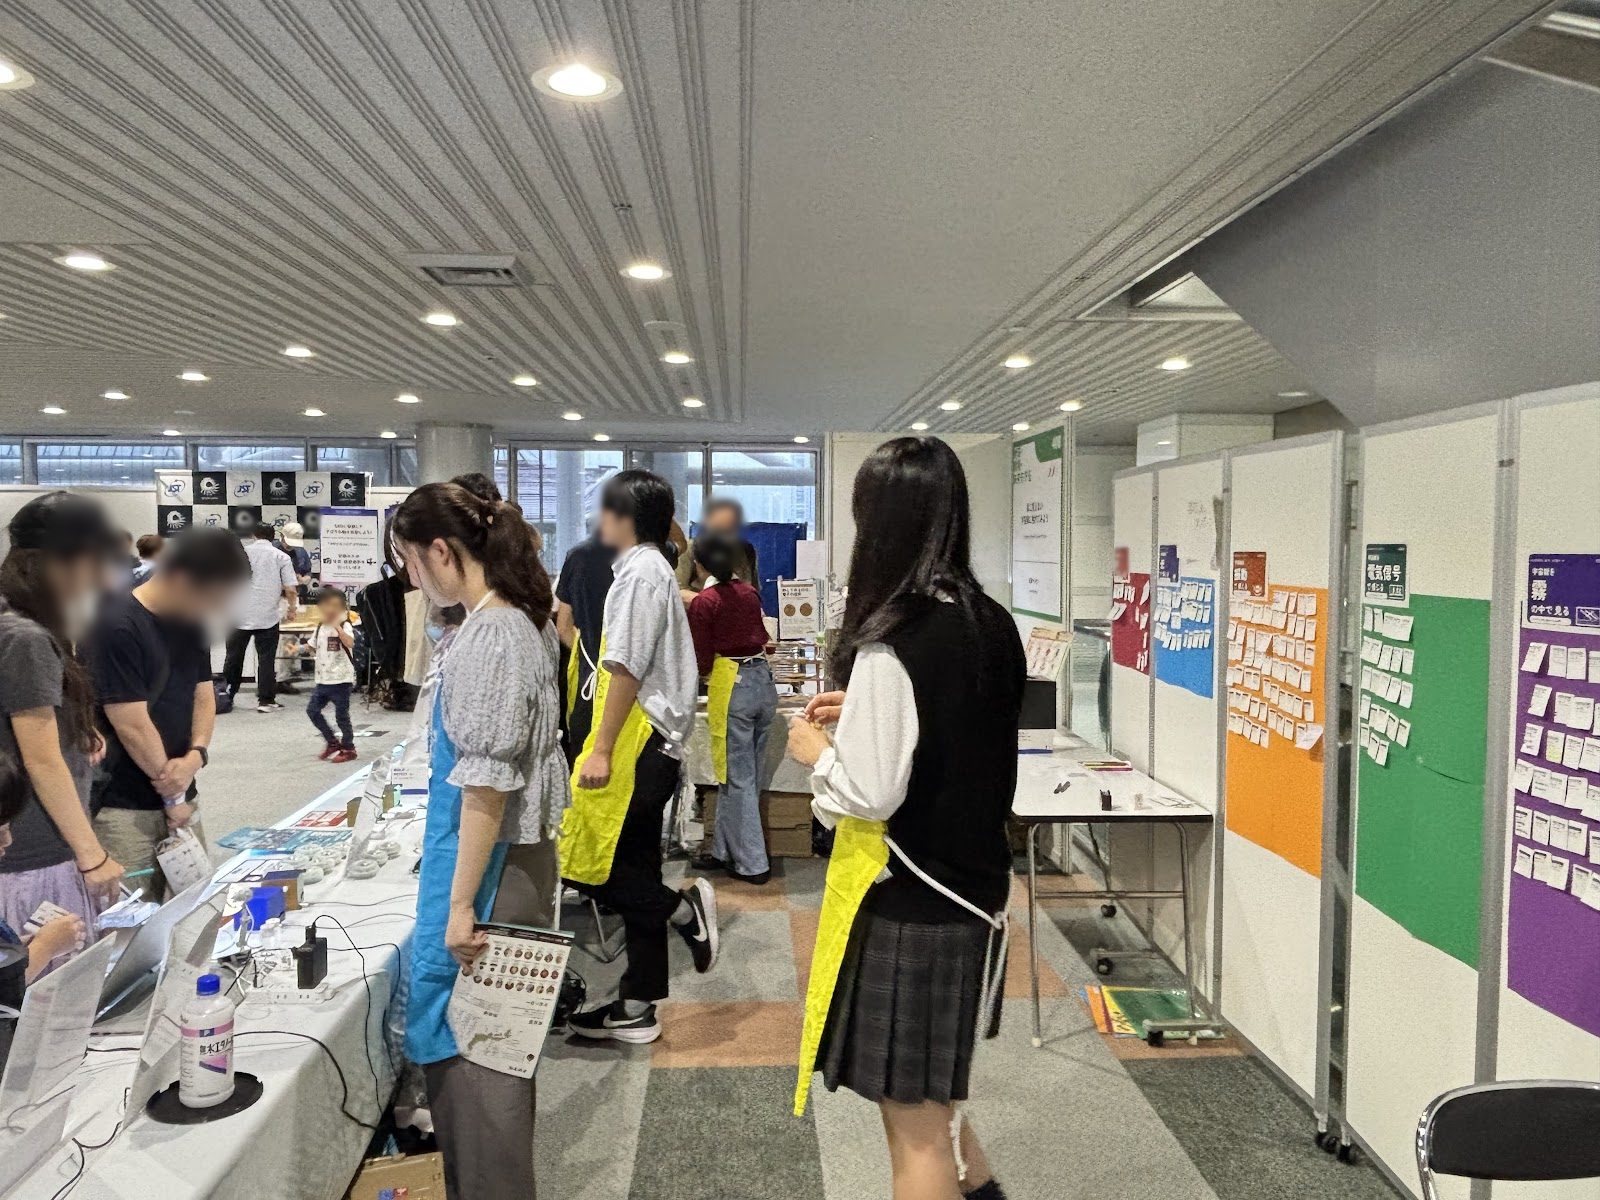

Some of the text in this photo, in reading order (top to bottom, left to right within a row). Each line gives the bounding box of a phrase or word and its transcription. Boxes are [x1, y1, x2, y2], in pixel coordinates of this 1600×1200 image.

[1367, 563, 1402, 581] 電気信号
[1531, 579, 1547, 601] 霧
[1530, 604, 1570, 616] の中で見る
